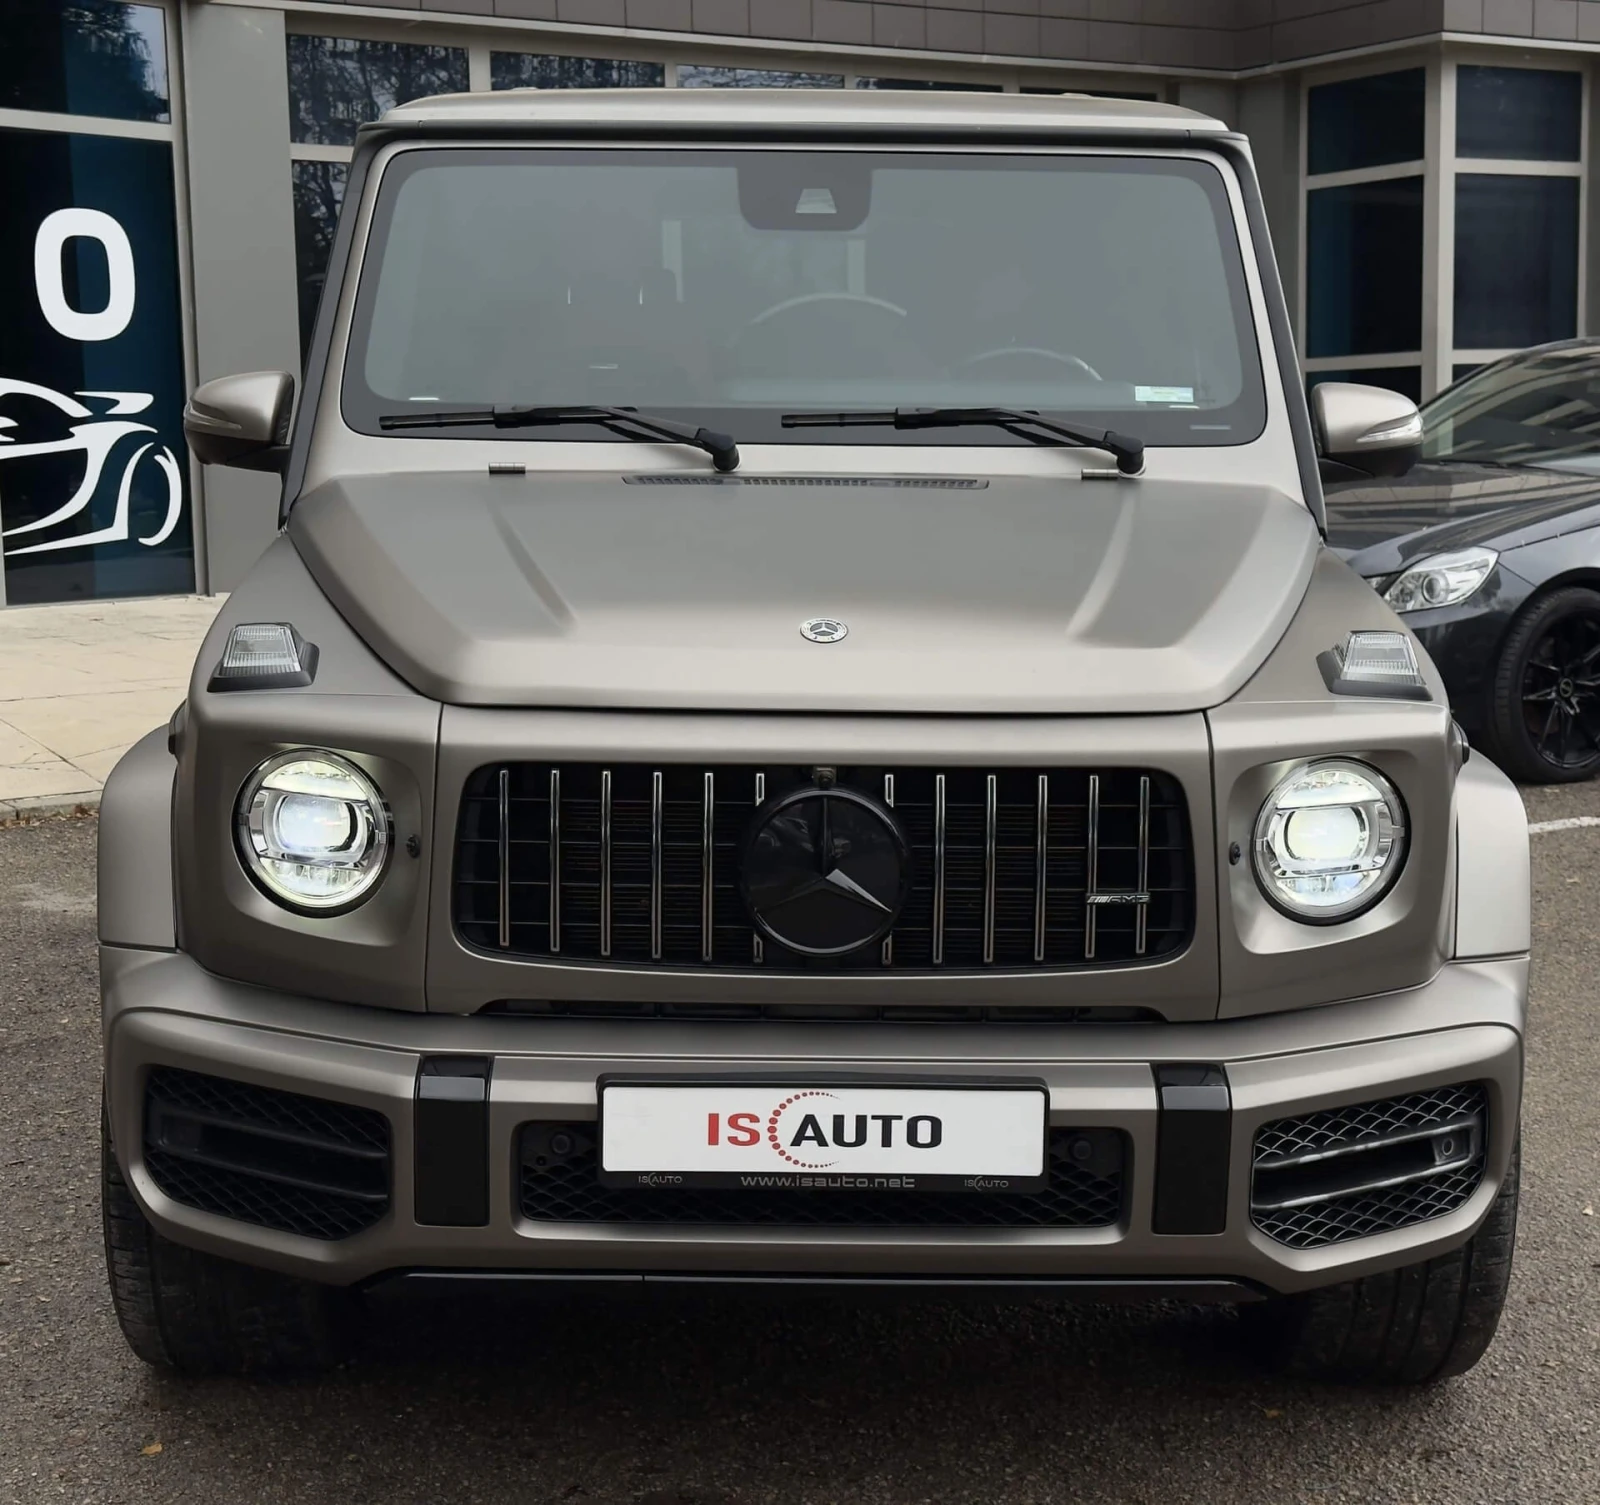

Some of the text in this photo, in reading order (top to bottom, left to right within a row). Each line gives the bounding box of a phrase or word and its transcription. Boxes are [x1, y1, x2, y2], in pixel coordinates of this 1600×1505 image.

[707, 1112, 943, 1149] IS AUTO
[740, 1175, 916, 1188] www.isauto.net
